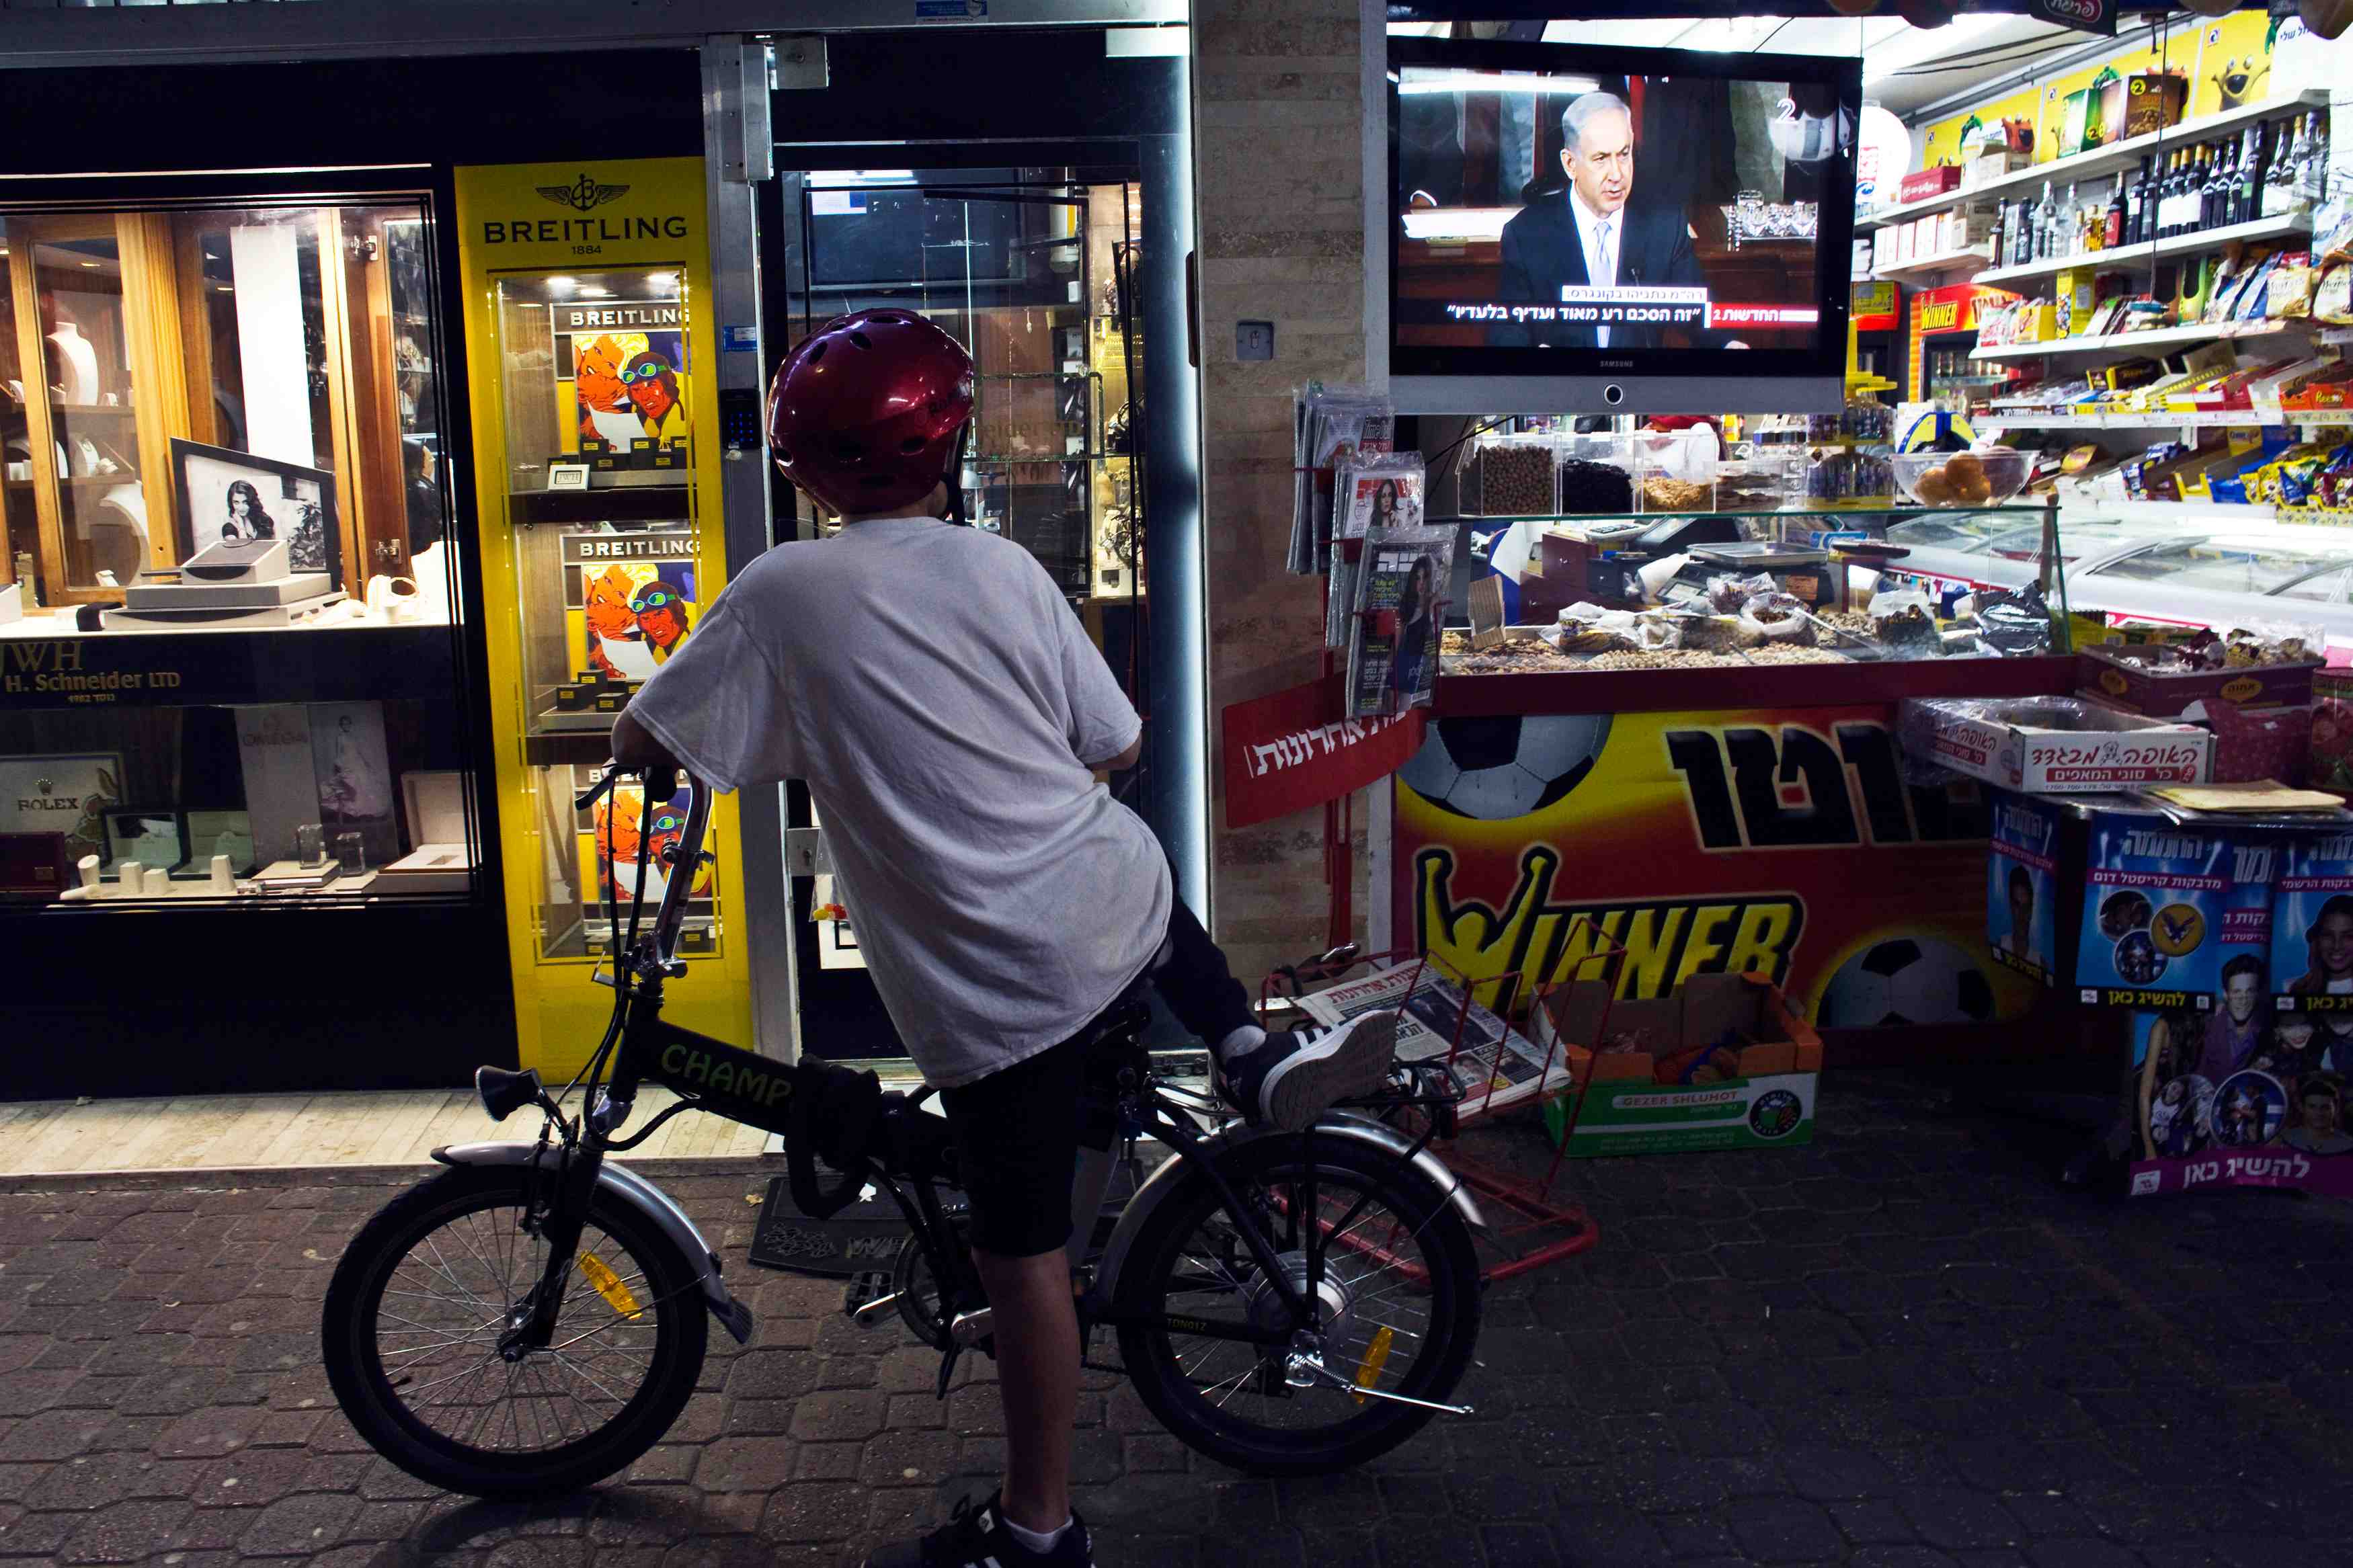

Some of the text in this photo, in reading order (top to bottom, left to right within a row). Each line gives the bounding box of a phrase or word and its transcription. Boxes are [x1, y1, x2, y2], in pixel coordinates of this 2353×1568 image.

[1775, 97, 1796, 123] 2
[483, 216, 688, 244] BREITLING
[571, 245, 602, 255] 1884
[1627, 290, 1665, 300] נתניהו
[569, 308, 690, 326] BREITLING
[1513, 306, 1555, 322] ועדיף
[1558, 307, 1598, 321] מאוד
[1601, 308, 1623, 321] רע
[1626, 307, 1671, 321] הסכם
[1713, 309, 1779, 321] החדשות 2
[1921, 292, 1958, 331] WINNER
[1599, 360, 1634, 368] SAMSUNG
[580, 539, 701, 557] BREITLING
[5, 671, 181, 692] H. Schneider LTD
[1252, 719, 1366, 776] אחרונות
[2119, 747, 2198, 765] האופה
[2054, 770, 2112, 781] המאפים
[2117, 770, 2146, 780] סוגי
[17, 797, 79, 812] ROLEX
[2093, 871, 2222, 889] מדבקות קריסטל דום
[2282, 877, 2319, 889] הרשמי
[1424, 854, 1795, 1009] WINNER
[1326, 980, 1388, 1004] אחרונות
[2108, 989, 2188, 1008] להשיג כאן
[2305, 995, 2335, 1010] כאן
[661, 1043, 793, 1107] CHAMP
[1624, 1091, 1738, 1107] GEZER SHLUHOT
[2184, 1153, 2311, 1189] להשיג כאן
